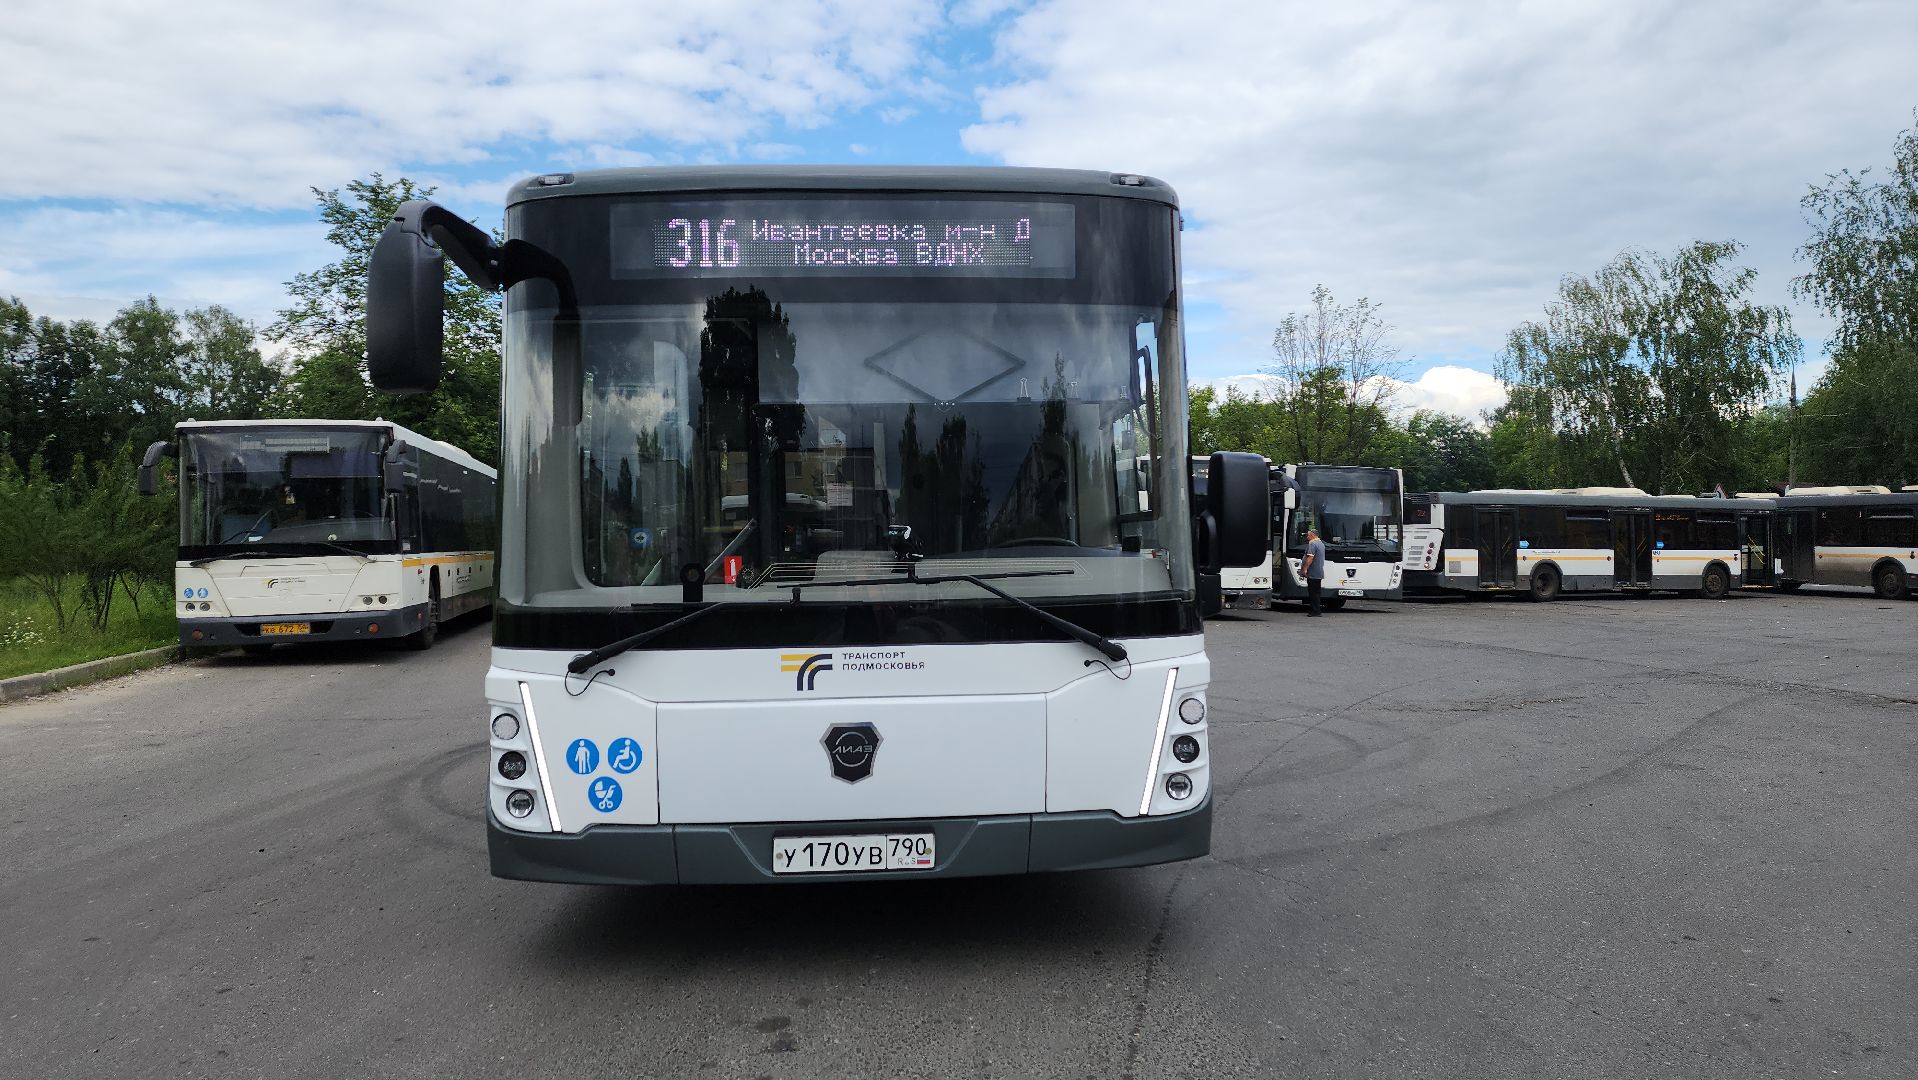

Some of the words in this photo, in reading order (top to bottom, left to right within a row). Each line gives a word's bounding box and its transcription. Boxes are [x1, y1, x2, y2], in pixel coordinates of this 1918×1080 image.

[752, 219, 926, 241] Ивантеевка
[945, 224, 996, 240] м-н
[668, 218, 739, 268] 316
[794, 242, 898, 264] Москва
[916, 242, 984, 267] ВДНХ
[842, 651, 906, 660] ТРАНСПОРТ
[842, 661, 926, 671] ПОДМОСКОВЬЯ
[832, 744, 873, 754] ЛИАЗ
[784, 842, 883, 867] У170УВ
[888, 837, 927, 857] 790
